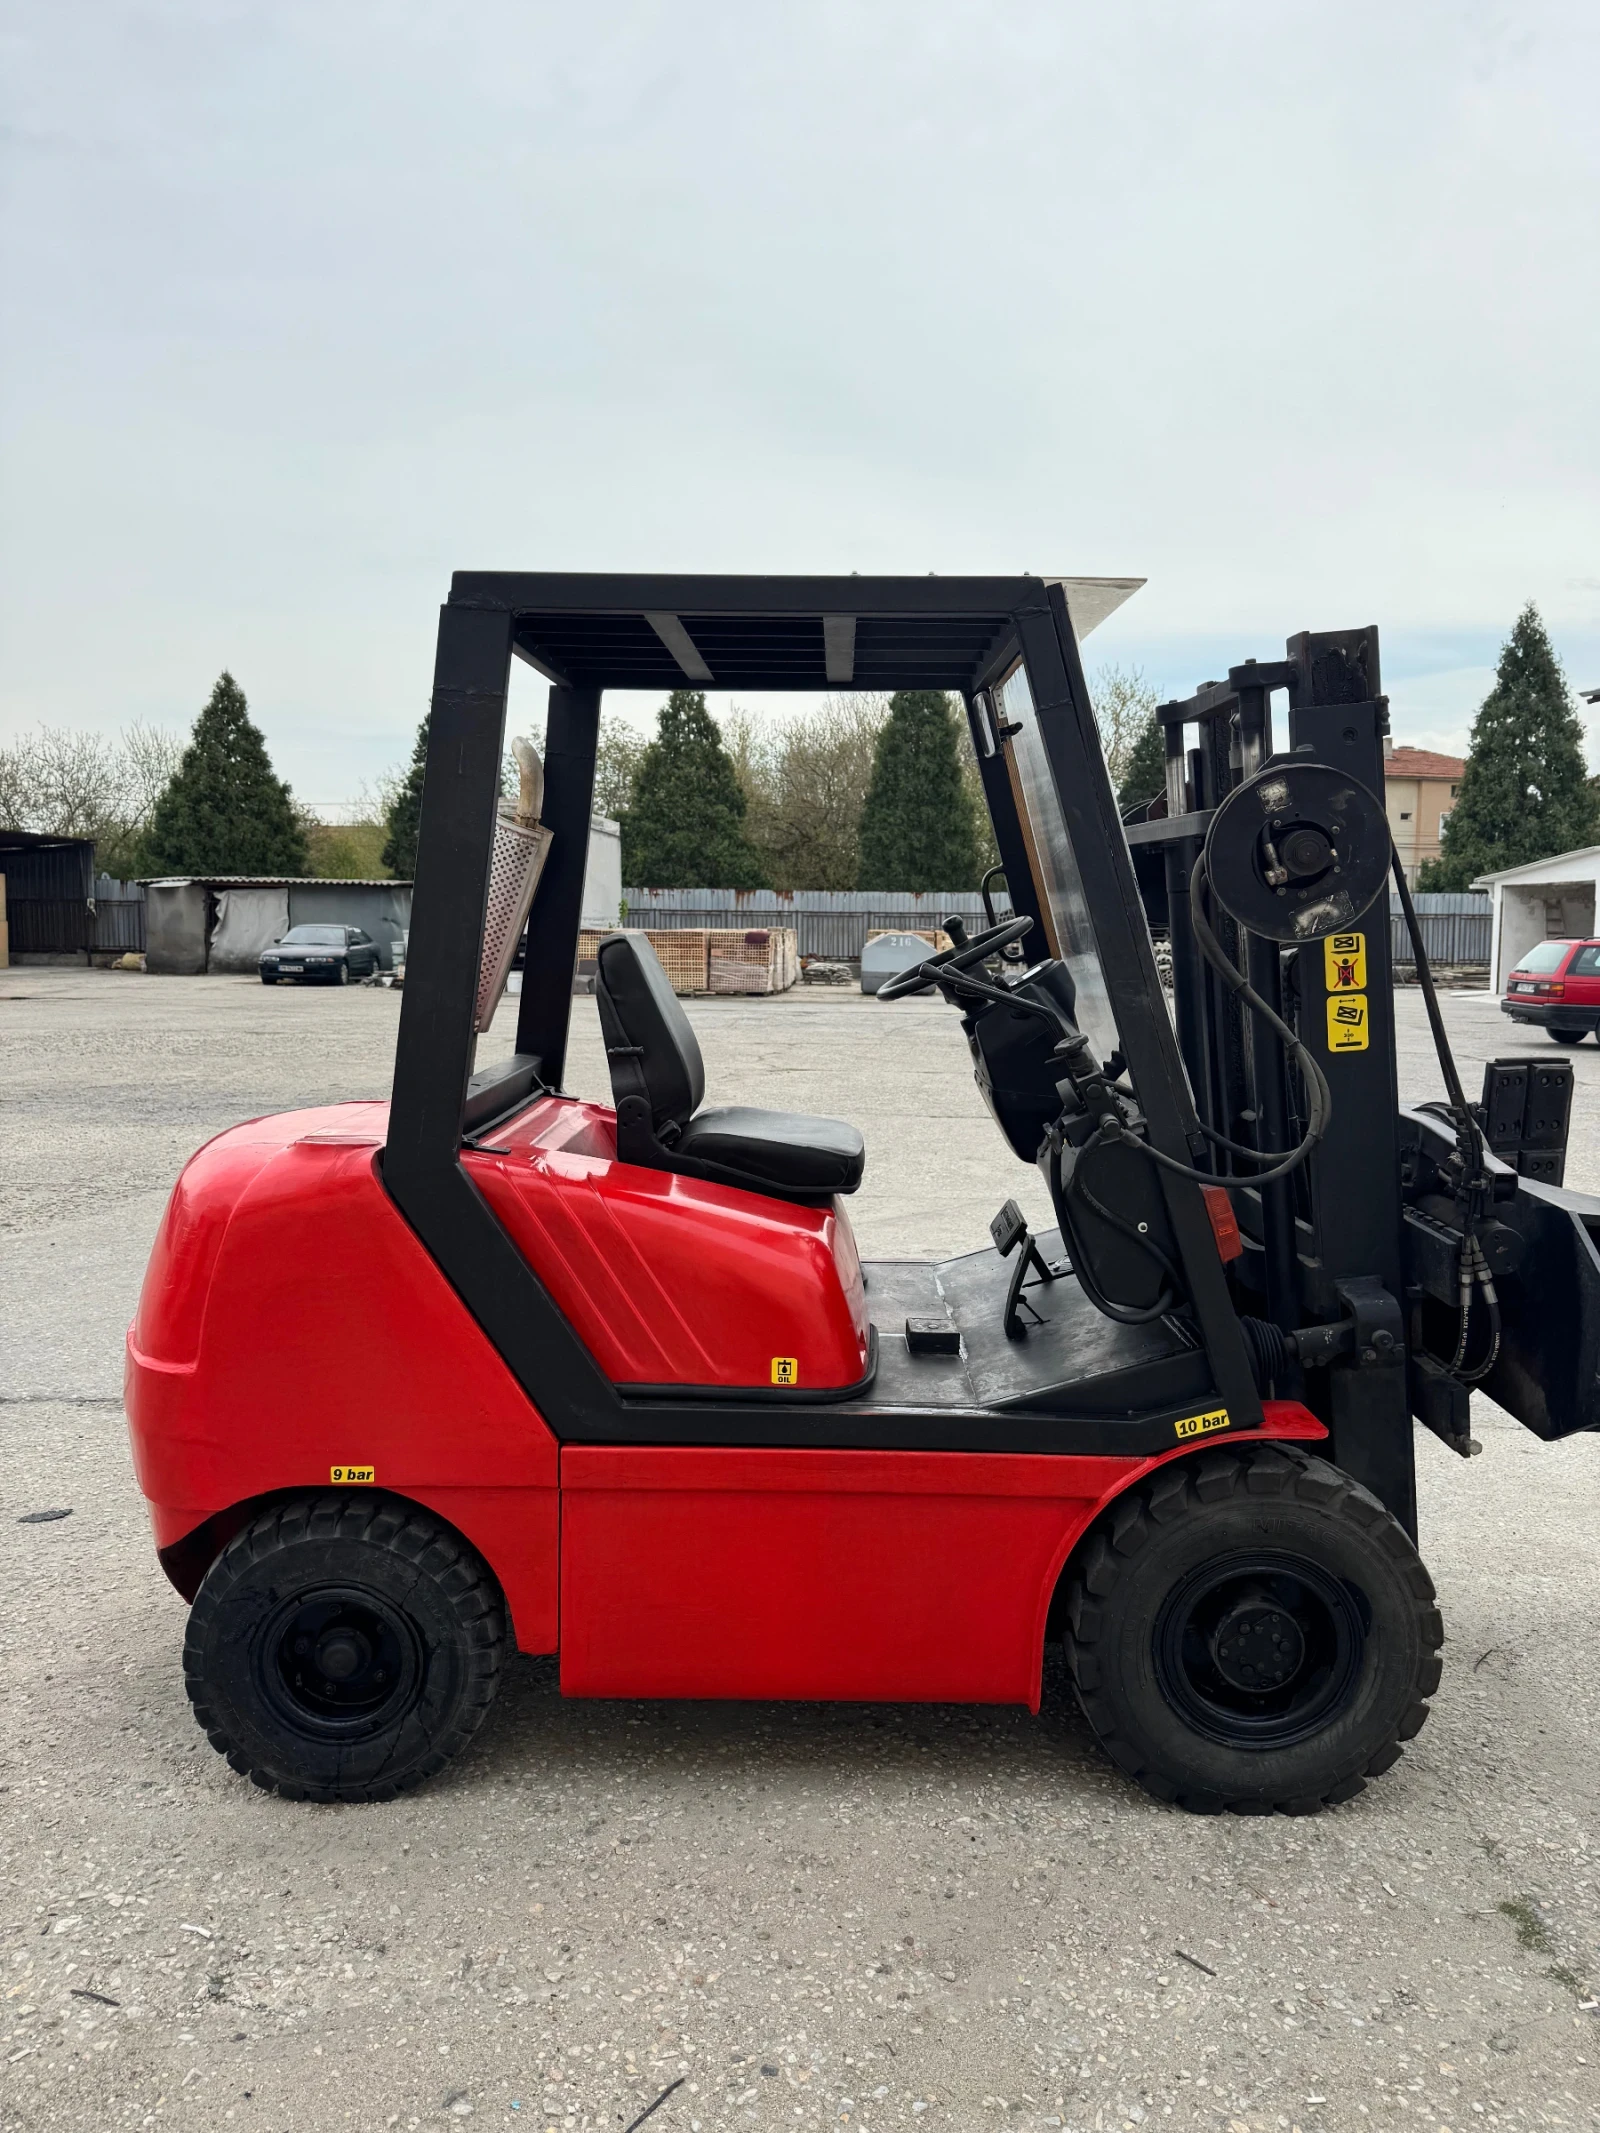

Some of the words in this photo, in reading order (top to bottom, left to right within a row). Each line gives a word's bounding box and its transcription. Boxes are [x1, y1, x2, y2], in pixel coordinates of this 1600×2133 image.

[1179, 1419, 1198, 1435] 10
[1202, 1414, 1227, 1430] bar
[333, 1468, 343, 1481] 9
[347, 1468, 373, 1481] bar
[1252, 1516, 1340, 1550] MITAS
